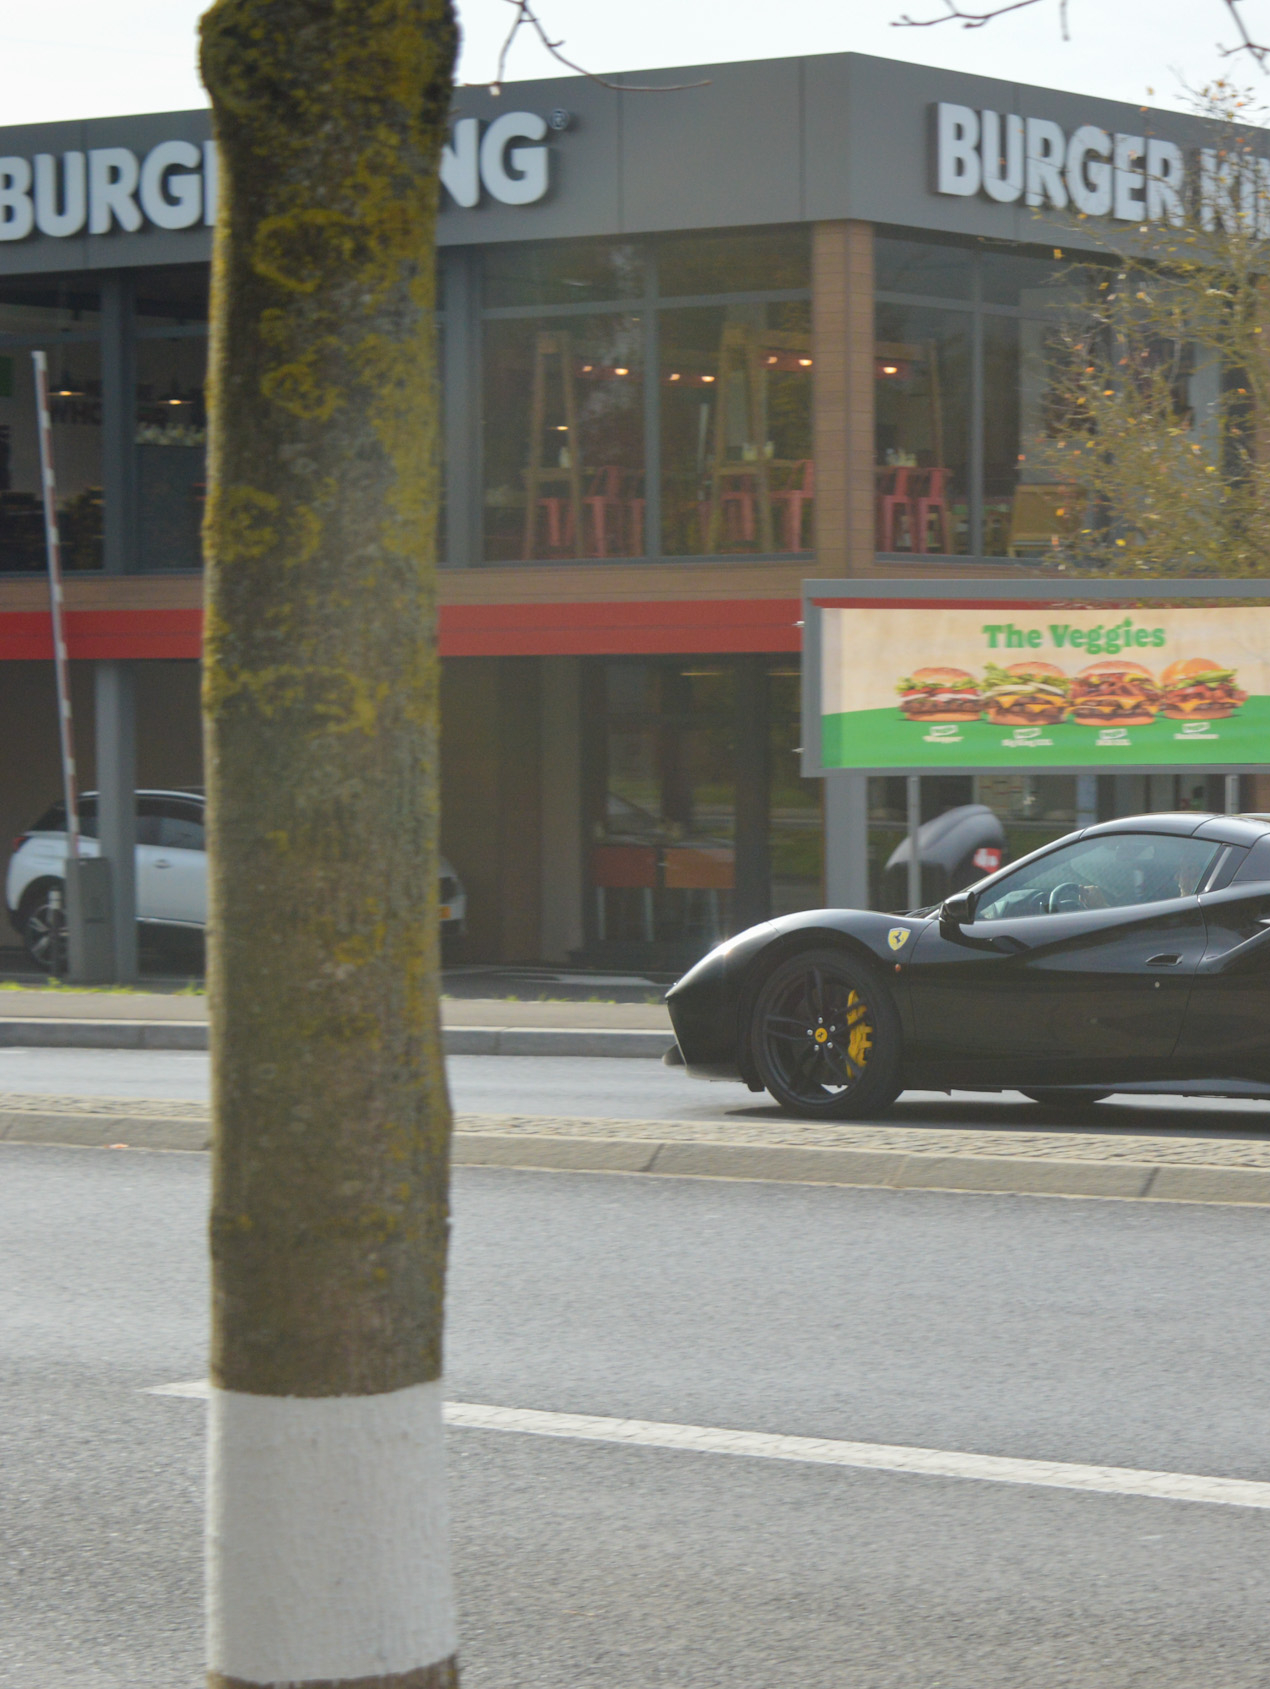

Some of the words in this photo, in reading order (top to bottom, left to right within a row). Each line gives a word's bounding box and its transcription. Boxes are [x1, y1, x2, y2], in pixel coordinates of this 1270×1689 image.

[0, 139, 219, 242] BURG
[439, 110, 549, 208] NG
[934, 101, 1187, 228] BURGER
[982, 622, 1043, 649] The
[1047, 616, 1167, 655] Veggies
